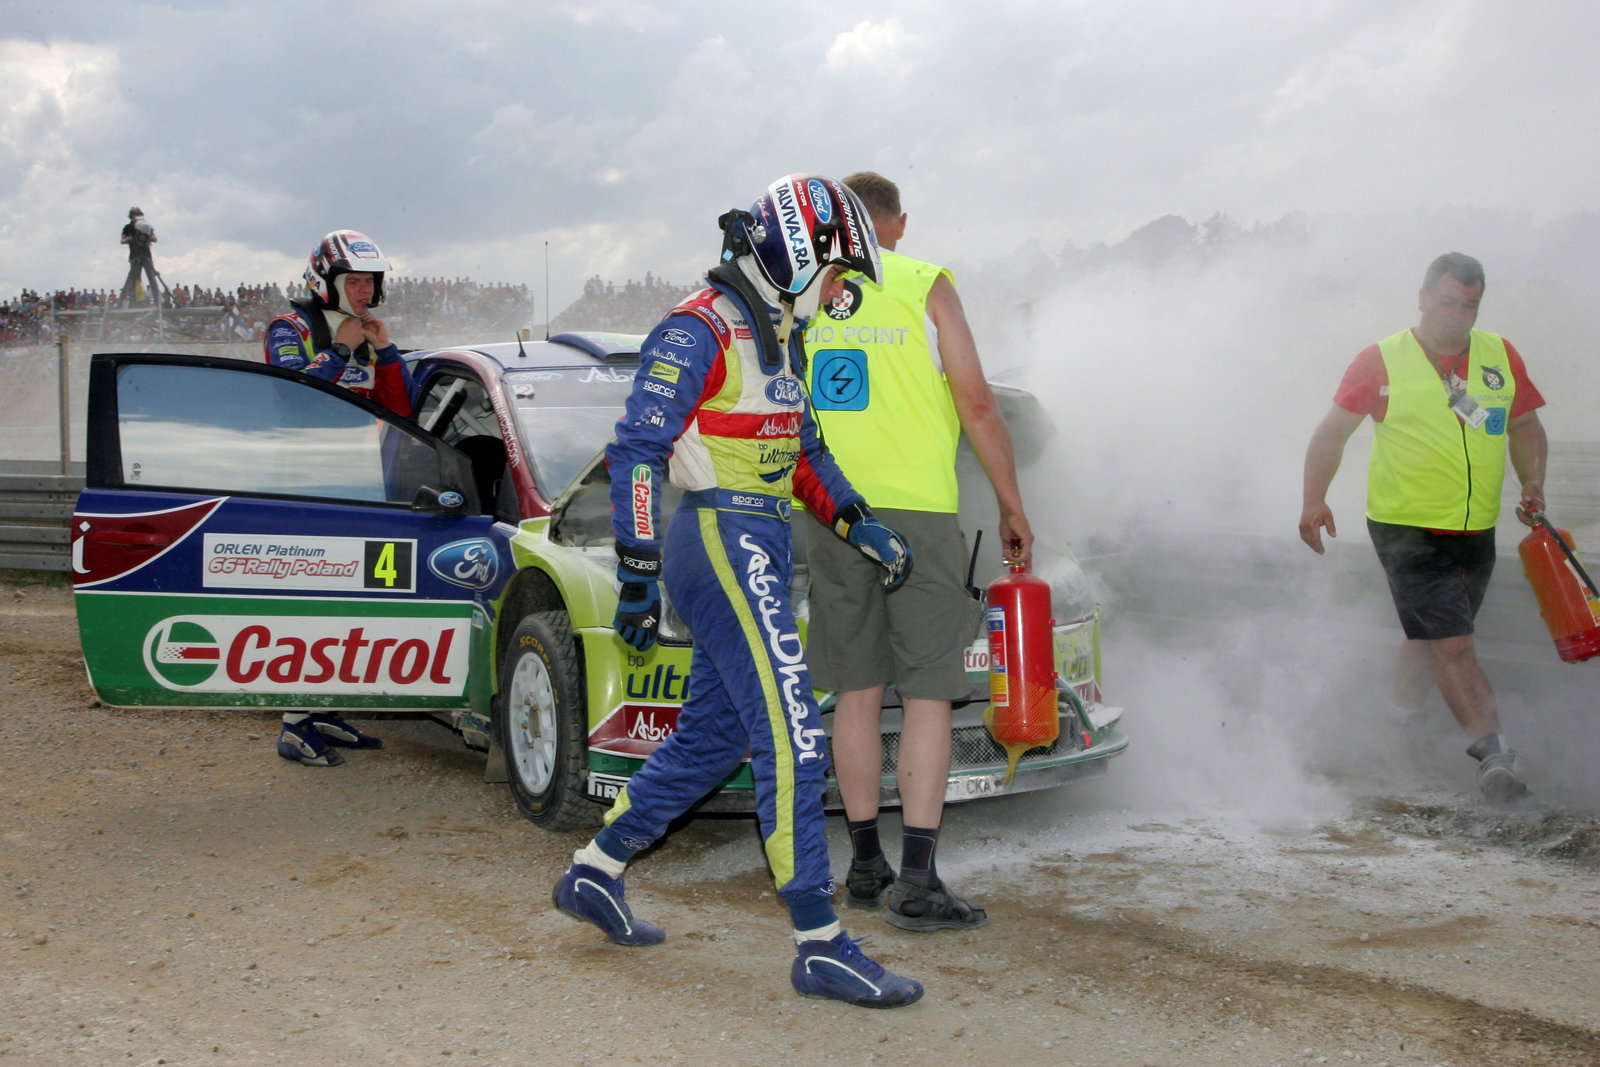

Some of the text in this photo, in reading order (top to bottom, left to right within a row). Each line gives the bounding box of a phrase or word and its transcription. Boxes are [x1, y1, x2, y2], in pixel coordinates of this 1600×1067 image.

[810, 183, 831, 214] Ford
[776, 183, 810, 271] TALVIVAARA
[697, 306, 727, 334] sparco
[829, 309, 851, 319] PZM
[664, 331, 689, 344] Ford
[805, 326, 909, 345] DIO POINT
[643, 380, 676, 399] sparco
[758, 442, 768, 451] bp
[634, 482, 653, 539] Castrol
[732, 495, 764, 507] sparco
[214, 543, 325, 557] ORLEN Platinum
[243, 558, 292, 579] Rally
[291, 560, 359, 577] Poland
[374, 543, 397, 587] 4
[454, 545, 492, 583] Ford
[624, 556, 658, 570] sparco
[226, 625, 456, 684] Castrol
[628, 651, 645, 670] bp
[587, 776, 624, 799] PIR
